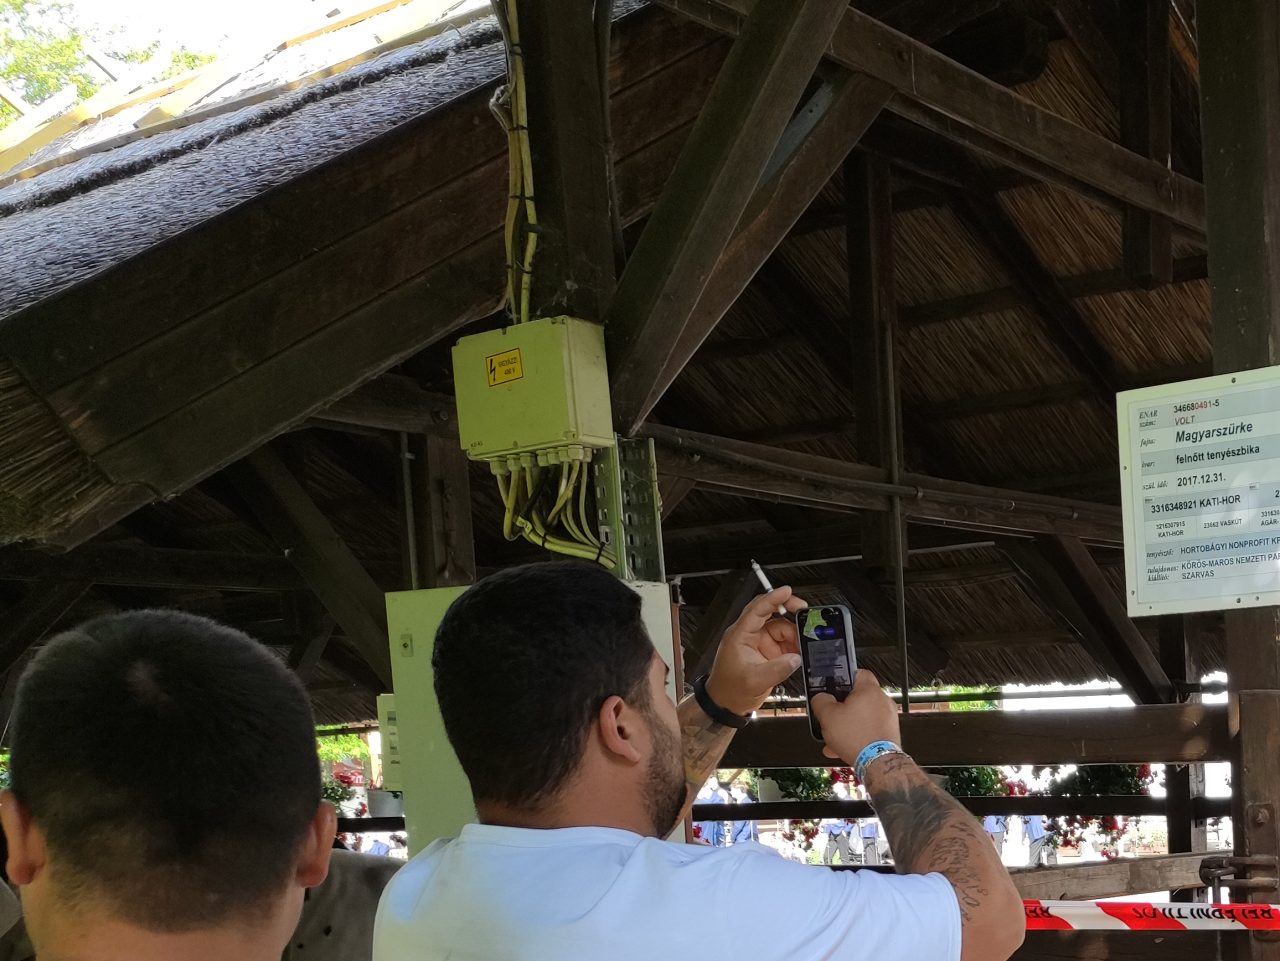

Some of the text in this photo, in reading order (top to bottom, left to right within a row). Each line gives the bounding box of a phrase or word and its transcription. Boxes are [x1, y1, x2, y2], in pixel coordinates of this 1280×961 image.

[1173, 399, 1220, 413] 346680491-5
[1174, 415, 1195, 426] VOLT
[1175, 422, 1253, 444] Magyarszürke
[1176, 445, 1260, 464] felnőtt tenyészbika
[1177, 472, 1226, 487] 2017.12.31.
[1199, 494, 1241, 508] KATI-HOR
[1180, 542, 1228, 555] HORTOBÁGYI
[1228, 537, 1270, 550] NONPROFIT
[1235, 554, 1266, 565] NEMZETI
[1182, 570, 1215, 580] SZARVAS
